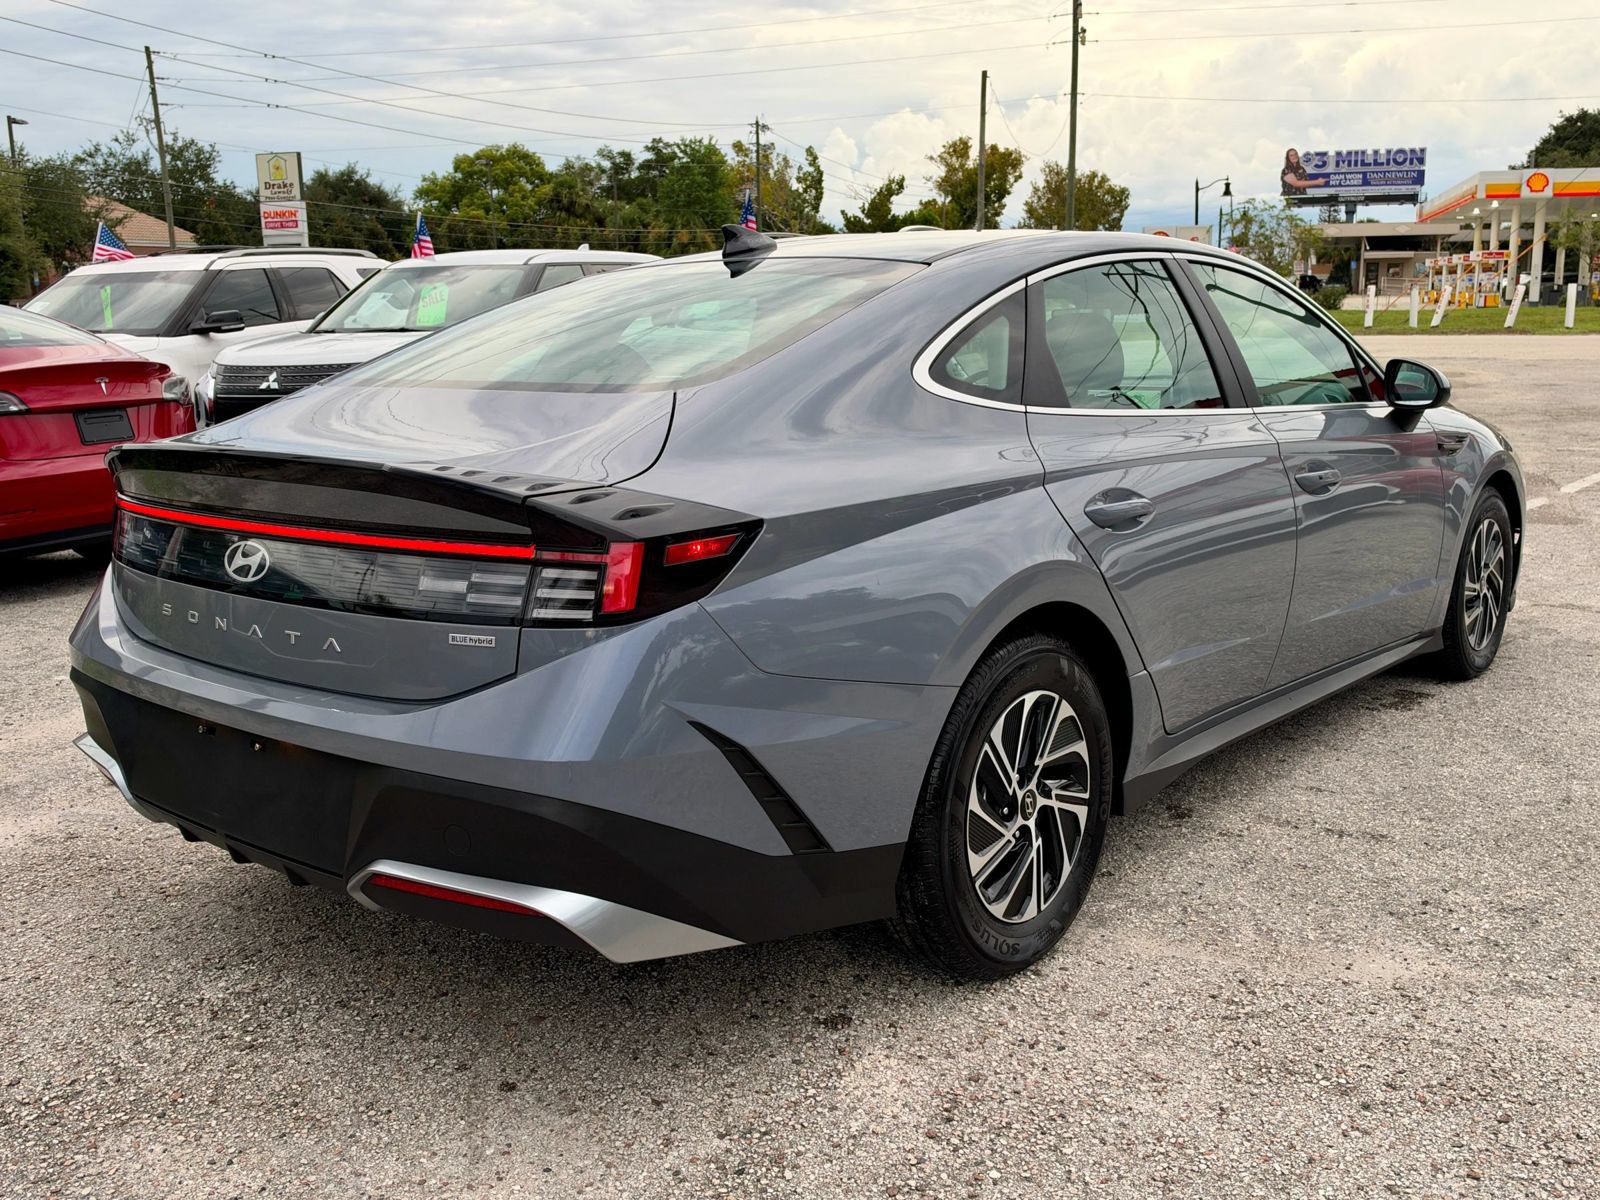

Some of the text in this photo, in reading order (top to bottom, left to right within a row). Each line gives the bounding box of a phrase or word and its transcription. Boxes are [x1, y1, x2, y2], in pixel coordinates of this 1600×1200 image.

[1302, 148, 1426, 169] $3 MILLION
[1385, 171, 1418, 179] NEWLIN
[264, 181, 294, 190] Drake
[162, 604, 342, 653] SONATA
[451, 635, 493, 646] BLUE hybrid
[971, 919, 1020, 956] SOLUS
